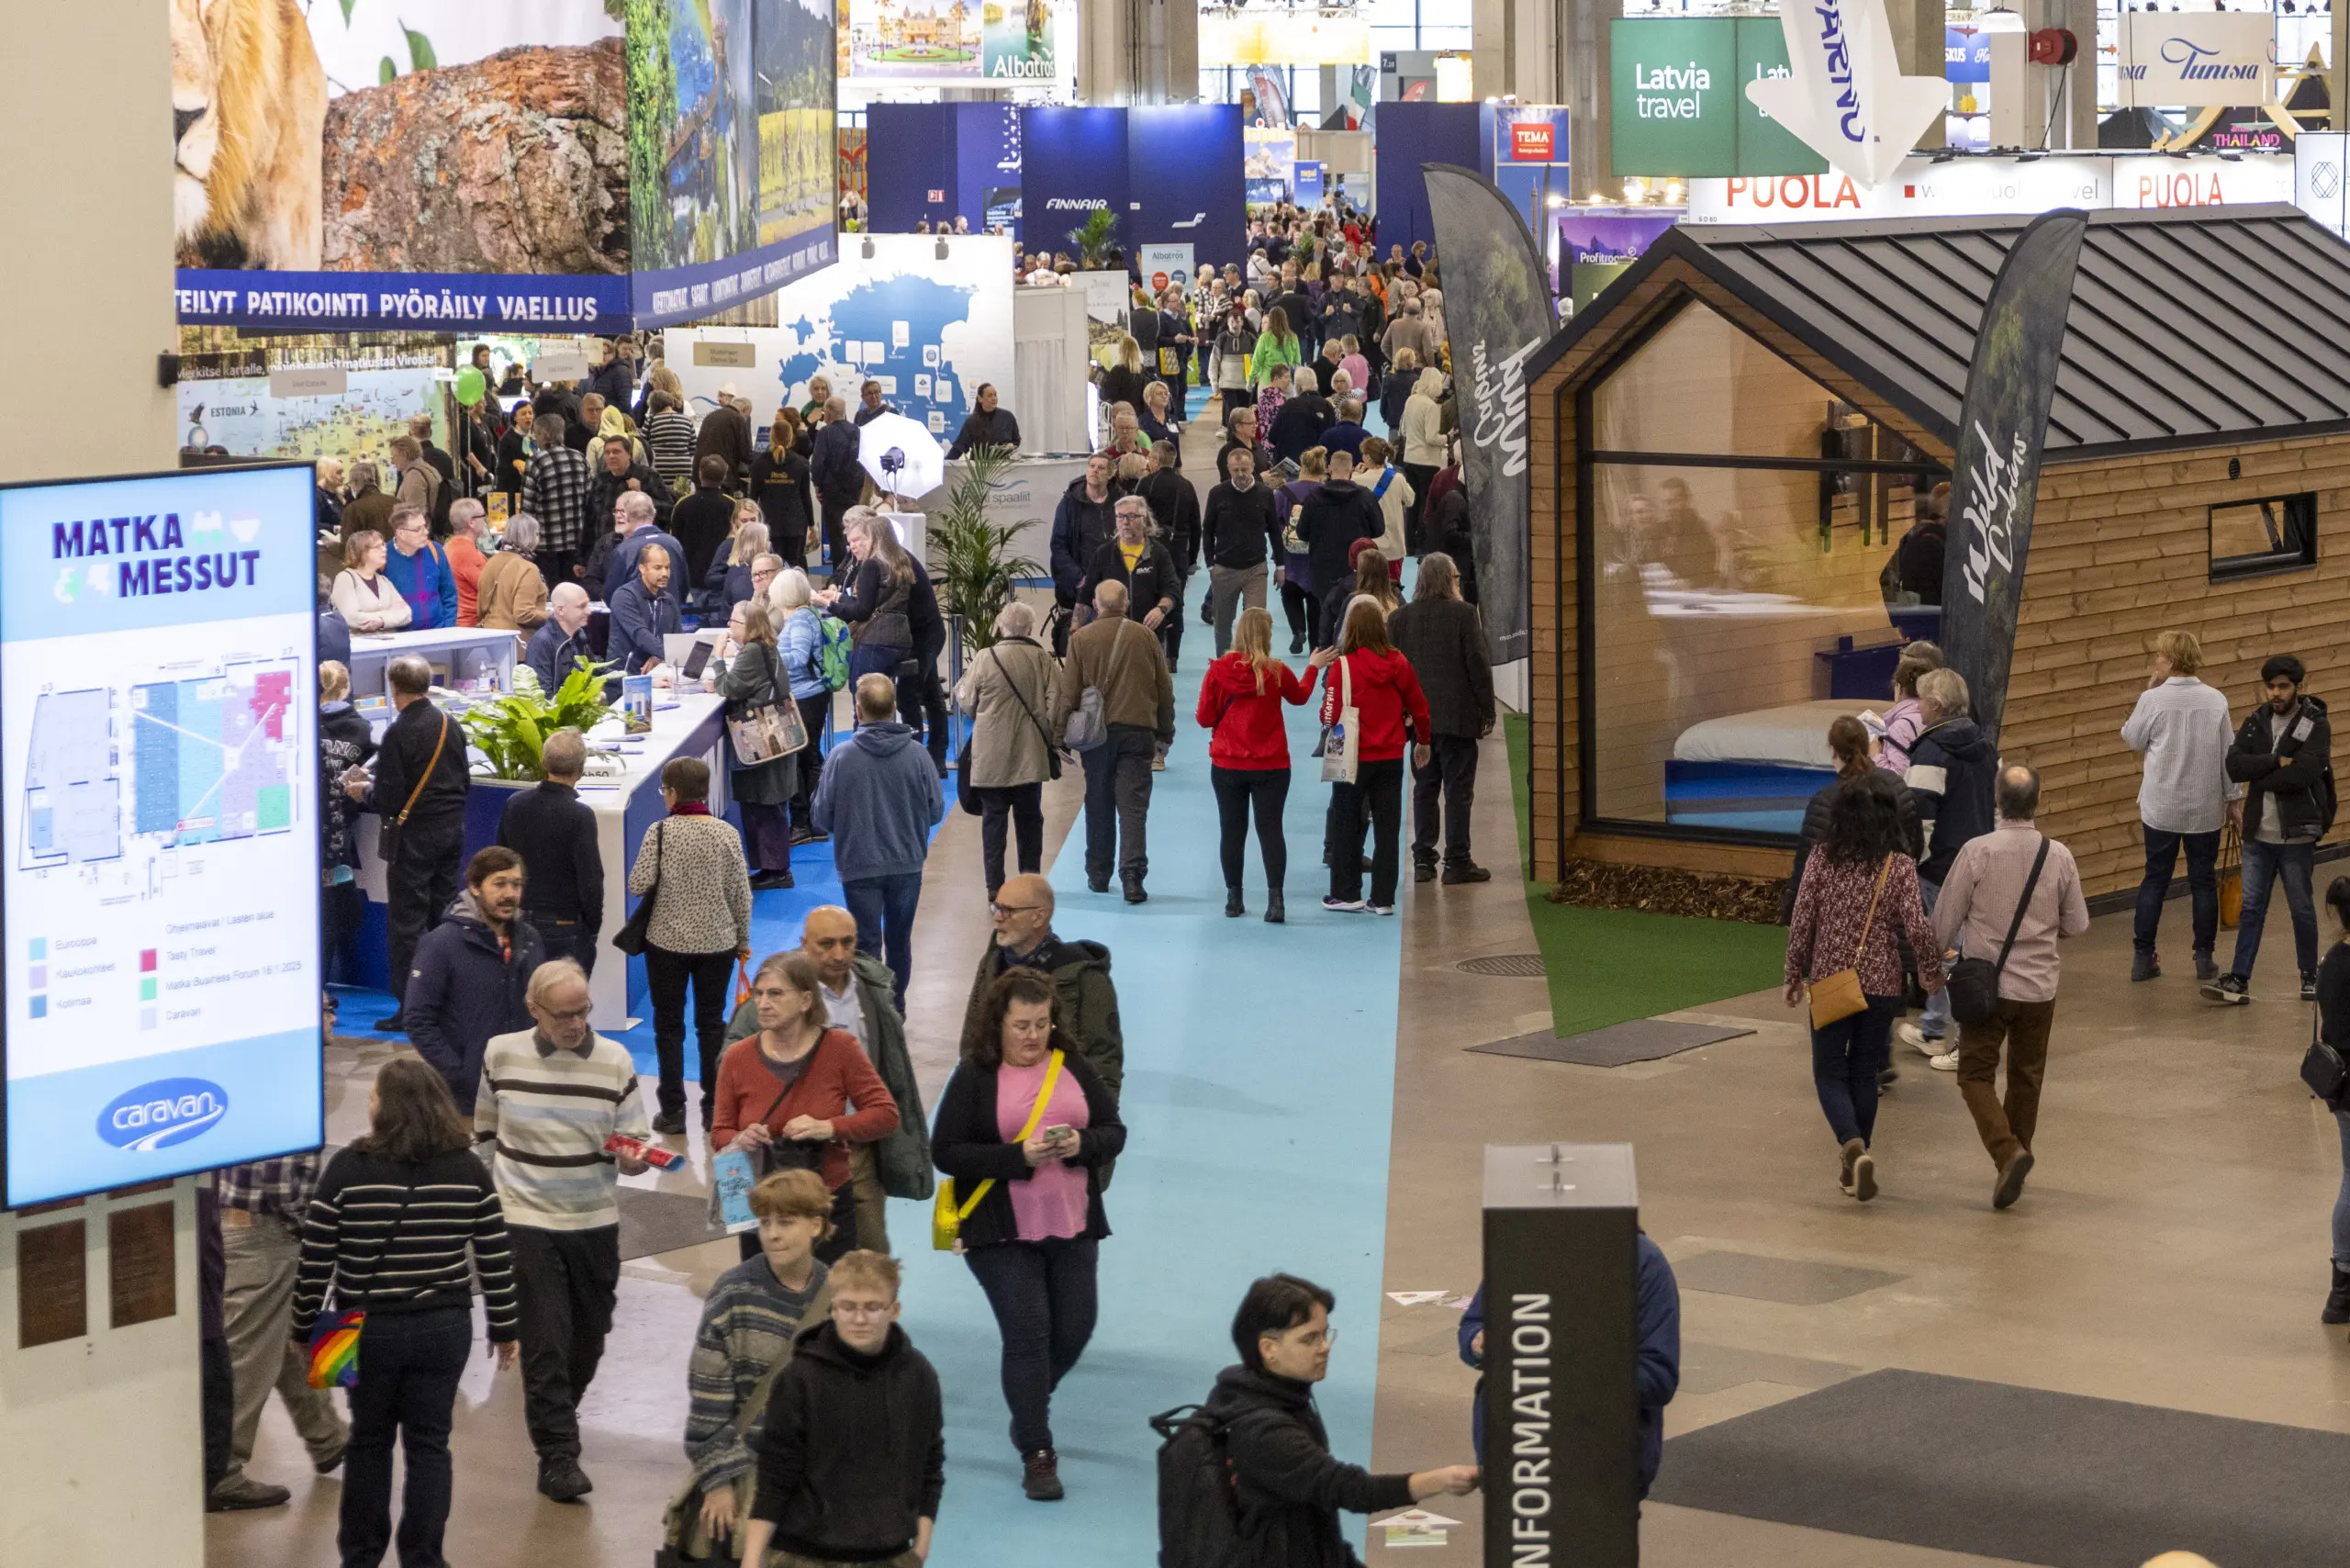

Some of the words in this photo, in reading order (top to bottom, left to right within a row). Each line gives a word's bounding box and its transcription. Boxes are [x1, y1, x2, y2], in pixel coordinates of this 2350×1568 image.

[992, 53, 1056, 77] Albatros
[1756, 62, 1794, 80] Latv
[1815, 0, 1865, 142] ÄRNU
[2161, 38, 2259, 80] Tunisia
[1636, 62, 1710, 90] Latvia
[1637, 91, 1699, 118] travel
[1516, 131, 1549, 142] TEMA
[2213, 133, 2280, 147] THAILAND
[1727, 175, 1861, 208] PUOLA
[2140, 173, 2224, 208] PUOLA
[1046, 198, 1107, 209] FINNAIR
[1580, 252, 1621, 263] Profitroo
[174, 289, 236, 314] TEILYT
[248, 291, 368, 317] PATIKOINTI
[380, 288, 487, 320] PYÖRÄILY
[497, 296, 599, 322] VAELLUS
[210, 406, 246, 418] ESTONIA
[1963, 420, 2005, 605] Wild
[1988, 431, 2027, 574] Cabins
[52, 512, 183, 560] MATKA
[118, 550, 261, 599] MESSUT
[227, 913, 254, 925] Lasten
[55, 935, 97, 950] Eurooppa
[166, 951, 187, 962] Tasty
[189, 946, 216, 958] Travel
[165, 979, 190, 991] Matka
[193, 974, 230, 987] Business
[233, 969, 260, 980] Forum
[56, 995, 92, 1010] Kotimaa
[165, 1007, 201, 1021] Caravan
[112, 1092, 216, 1130] caravan
[1511, 1293, 1552, 1568] NFORMATION
